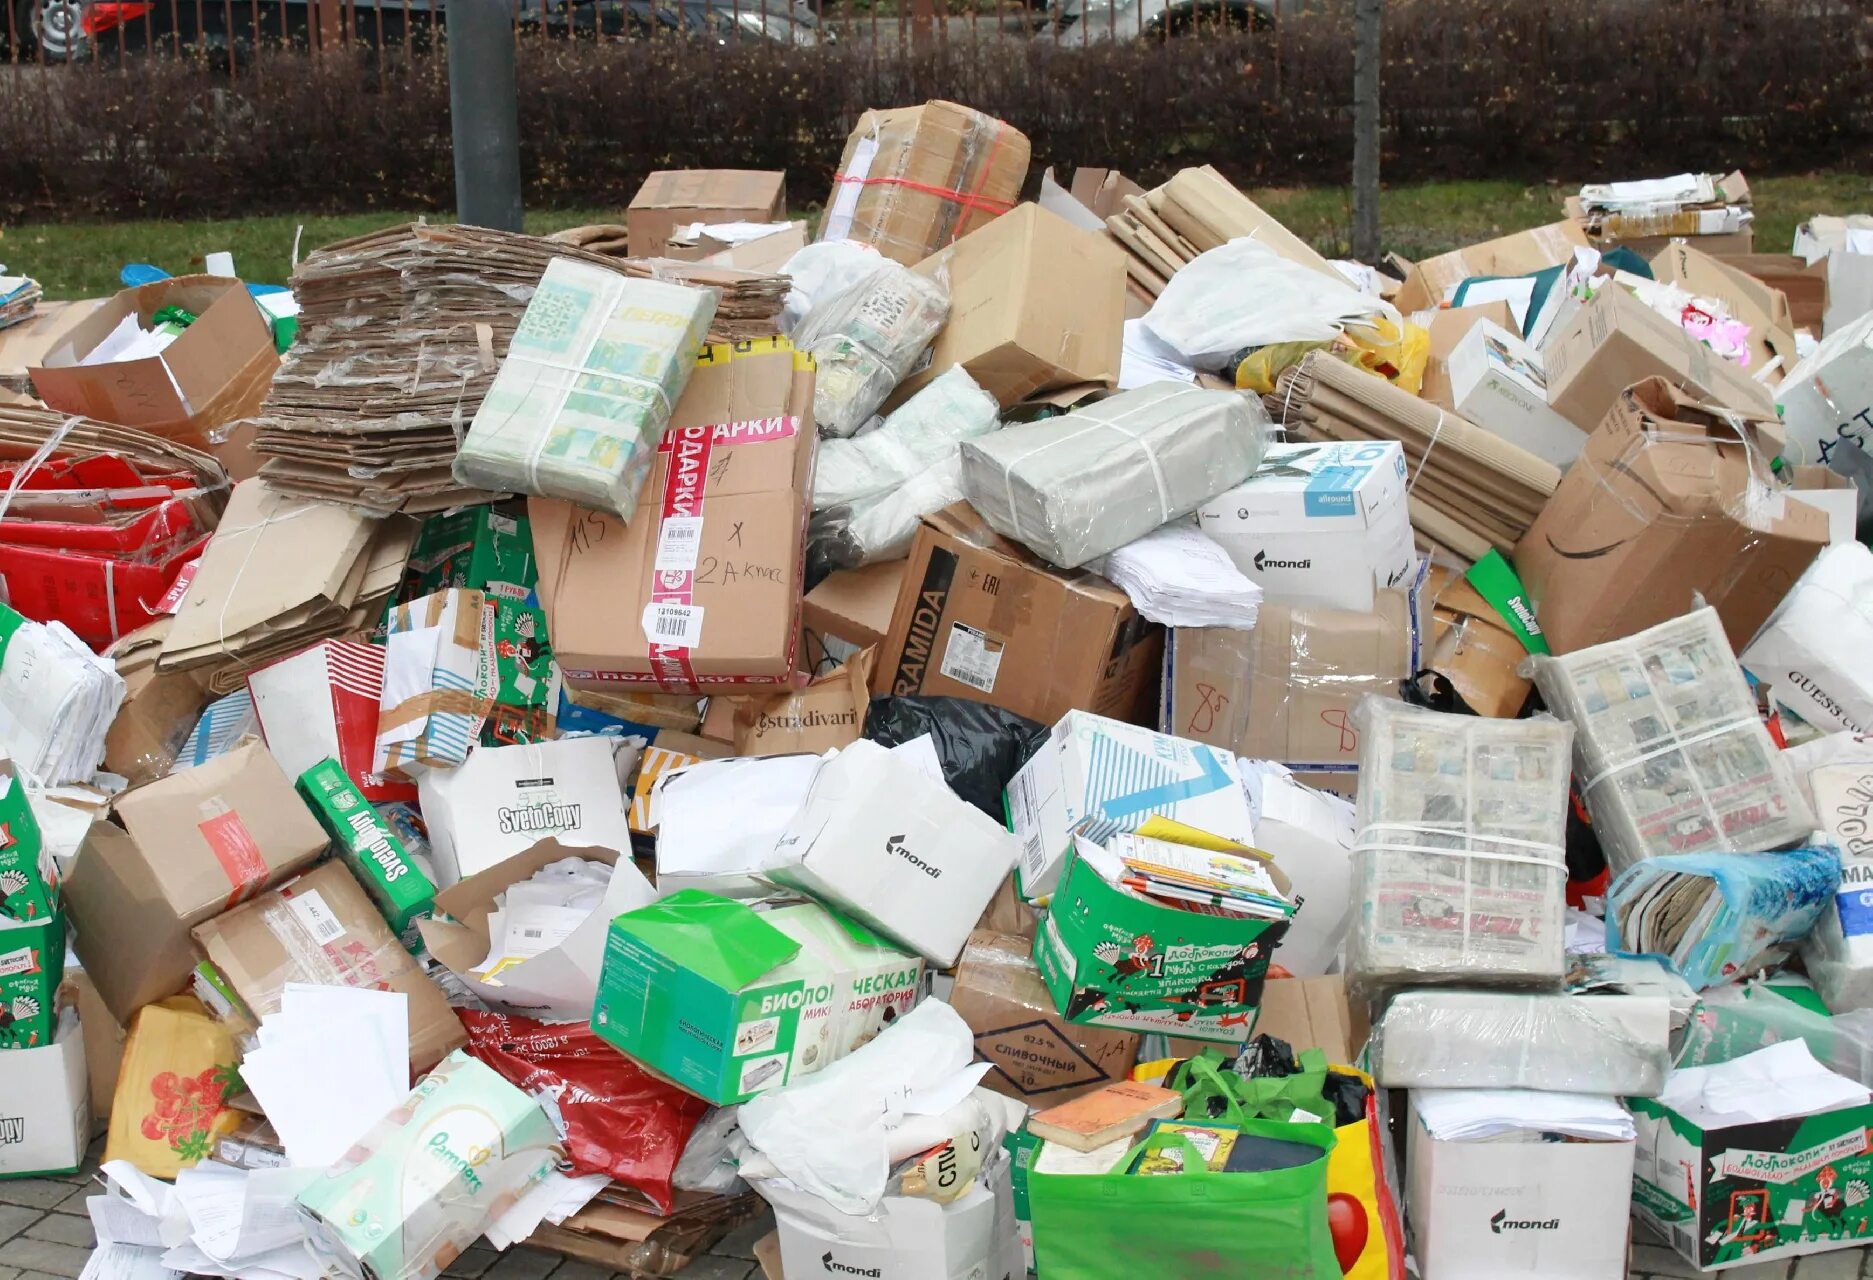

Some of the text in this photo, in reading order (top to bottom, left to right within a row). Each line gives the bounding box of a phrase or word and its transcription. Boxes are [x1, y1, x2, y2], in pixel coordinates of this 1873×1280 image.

[1393, 454, 1407, 480] IQ
[1318, 494, 1351, 504] allround
[1264, 558, 1311, 570] mondi
[166, 575, 191, 603] SPLAT
[1506, 595, 1542, 636] SvetoCopy
[601, 672, 735, 683] ПОДКИ
[498, 802, 582, 834] SvetoCopy
[347, 809, 409, 883] Svetoopy
[895, 845, 942, 880] mondi
[1149, 954, 1166, 978] 1
[760, 967, 917, 1015] БИОЛОЧЕСКАЯ
[803, 988, 916, 1021] МИКАБОРАТОРИЯ
[994, 1043, 1077, 1073] СЛИВОЧНЫЙ
[1020, 1073, 1035, 1086] 10
[429, 1131, 482, 1196] Pampers
[1502, 1218, 1560, 1231] mondi
[832, 1262, 881, 1279] mondi
